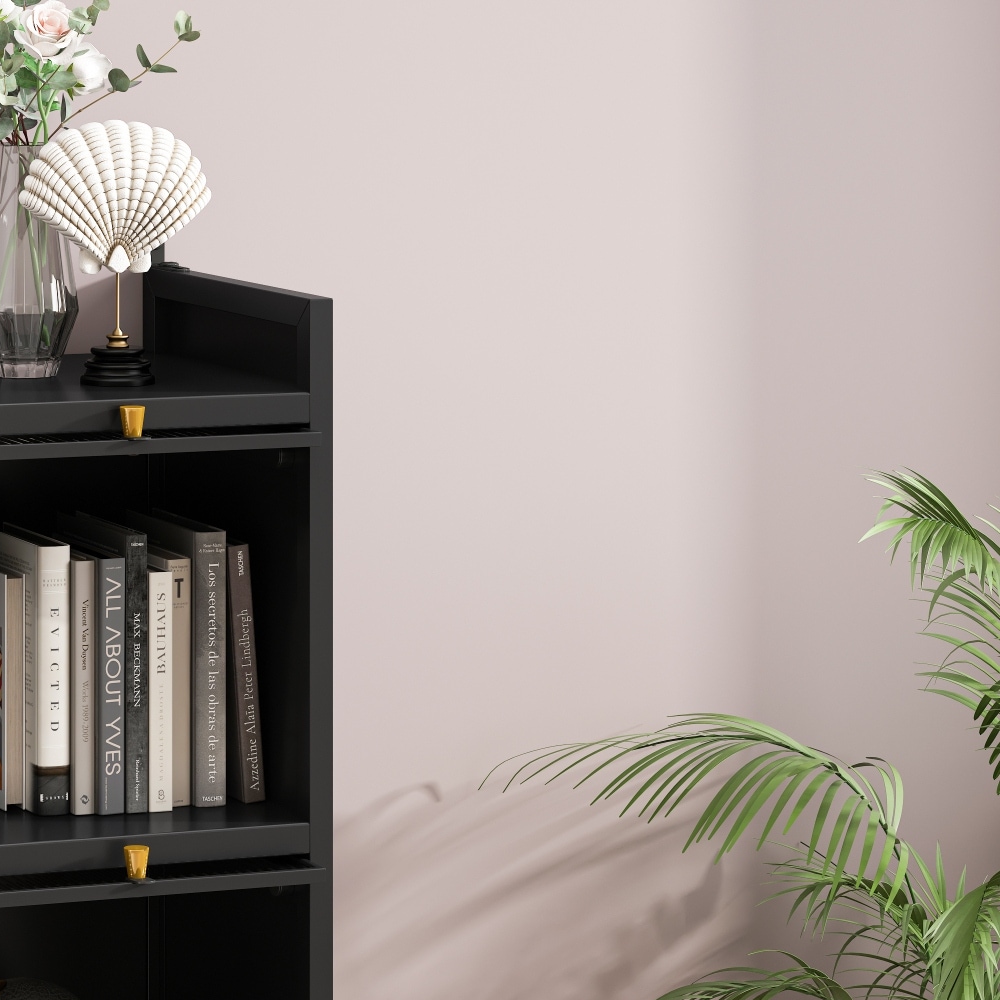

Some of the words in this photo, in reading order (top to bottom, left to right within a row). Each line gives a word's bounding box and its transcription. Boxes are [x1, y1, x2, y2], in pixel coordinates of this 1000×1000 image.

[208, 562, 219, 587] Los
[237, 550, 245, 576] TASCHEN
[105, 577, 121, 618] ALL
[174, 578, 184, 598] T
[81, 599, 89, 626] Vincent
[133, 612, 141, 638] MAX
[208, 591, 218, 647] secretos
[81, 628, 89, 642] Van
[157, 592, 166, 674] BAUHAUS
[237, 609, 252, 668] Lindbergh
[50, 608, 60, 732] EVICTED
[80, 644, 89, 671] Duysen
[105, 625, 121, 706] ABOUT
[208, 651, 219, 667] de
[133, 643, 141, 707] BECKMANN
[208, 671, 219, 690] las
[243, 671, 254, 700] Peter
[208, 694, 219, 731] obras
[105, 716, 121, 776] YVES
[208, 735, 219, 751] de
[208, 754, 218, 783] arte
[246, 738, 260, 791] Azzedine
